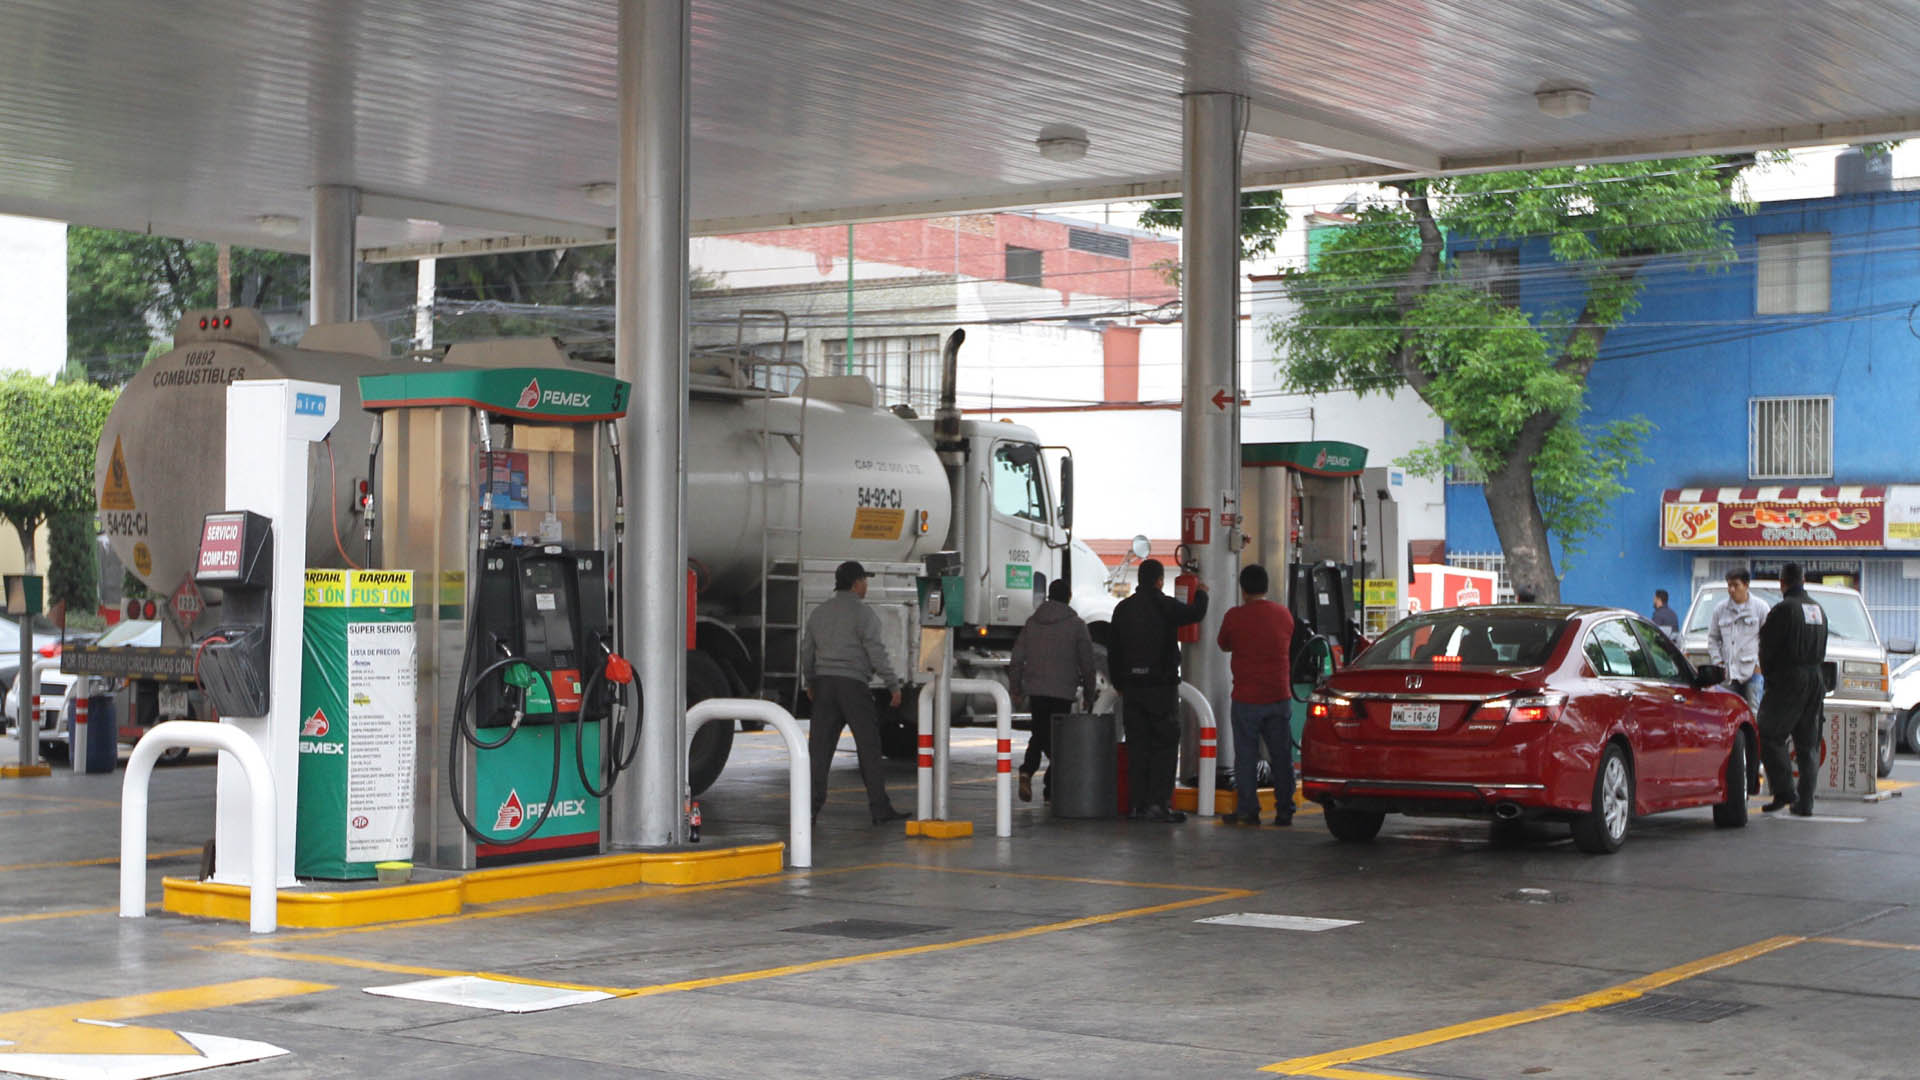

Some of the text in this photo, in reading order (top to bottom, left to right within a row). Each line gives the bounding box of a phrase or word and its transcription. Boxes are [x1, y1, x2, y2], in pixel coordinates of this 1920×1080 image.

[184, 350, 216, 367] 10892
[153, 367, 245, 388] COMBUSTIBLES
[542, 390, 592, 407] PEMEX
[611, 383, 623, 411] 5
[1326, 455, 1351, 467] PEMEX
[858, 488, 902, 508] 54-92-CJ
[107, 512, 149, 536] 54-92-CJ
[207, 525, 238, 541] SERVICIO
[202, 550, 237, 567] COMPLETO
[1008, 549, 1030, 562] 10892
[305, 573, 341, 584] ARDAHL
[359, 573, 407, 584] BARDAHL
[304, 586, 344, 603] S1ÓN
[376, 624, 412, 634] SERVICIO
[367, 648, 375, 656] DE
[376, 648, 400, 656] PRECIOS
[175, 658, 191, 672] CON
[300, 742, 344, 755] EMEX
[1829, 713, 1840, 788] PRECAUCION
